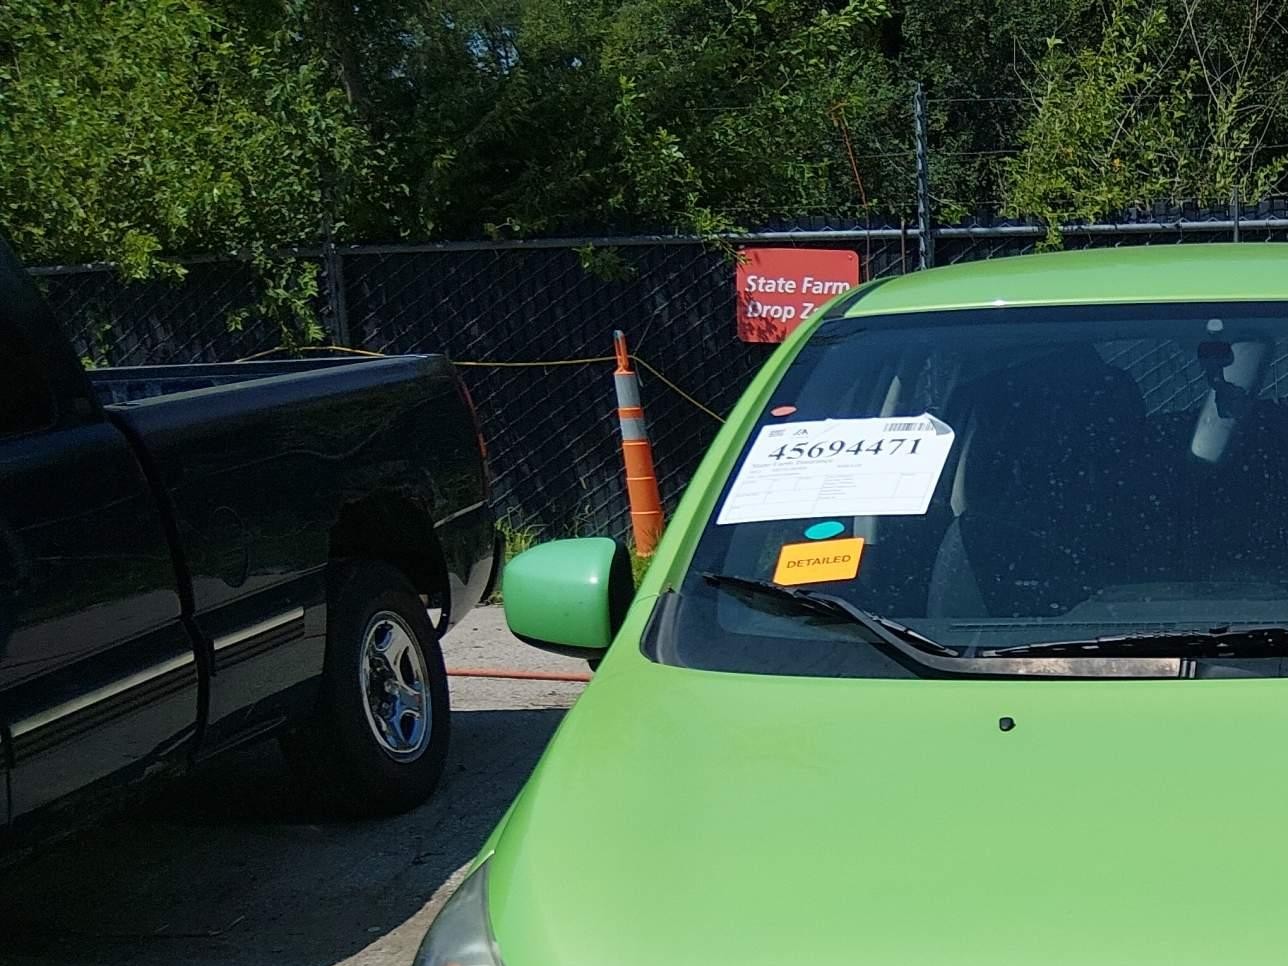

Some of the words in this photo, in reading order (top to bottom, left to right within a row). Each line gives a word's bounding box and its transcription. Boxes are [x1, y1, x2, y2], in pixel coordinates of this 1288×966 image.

[745, 275, 797, 293] State
[802, 277, 850, 294] Farm
[747, 301, 796, 323] Drop
[768, 438, 922, 461] 45694471
[786, 554, 852, 569] DETAILED
